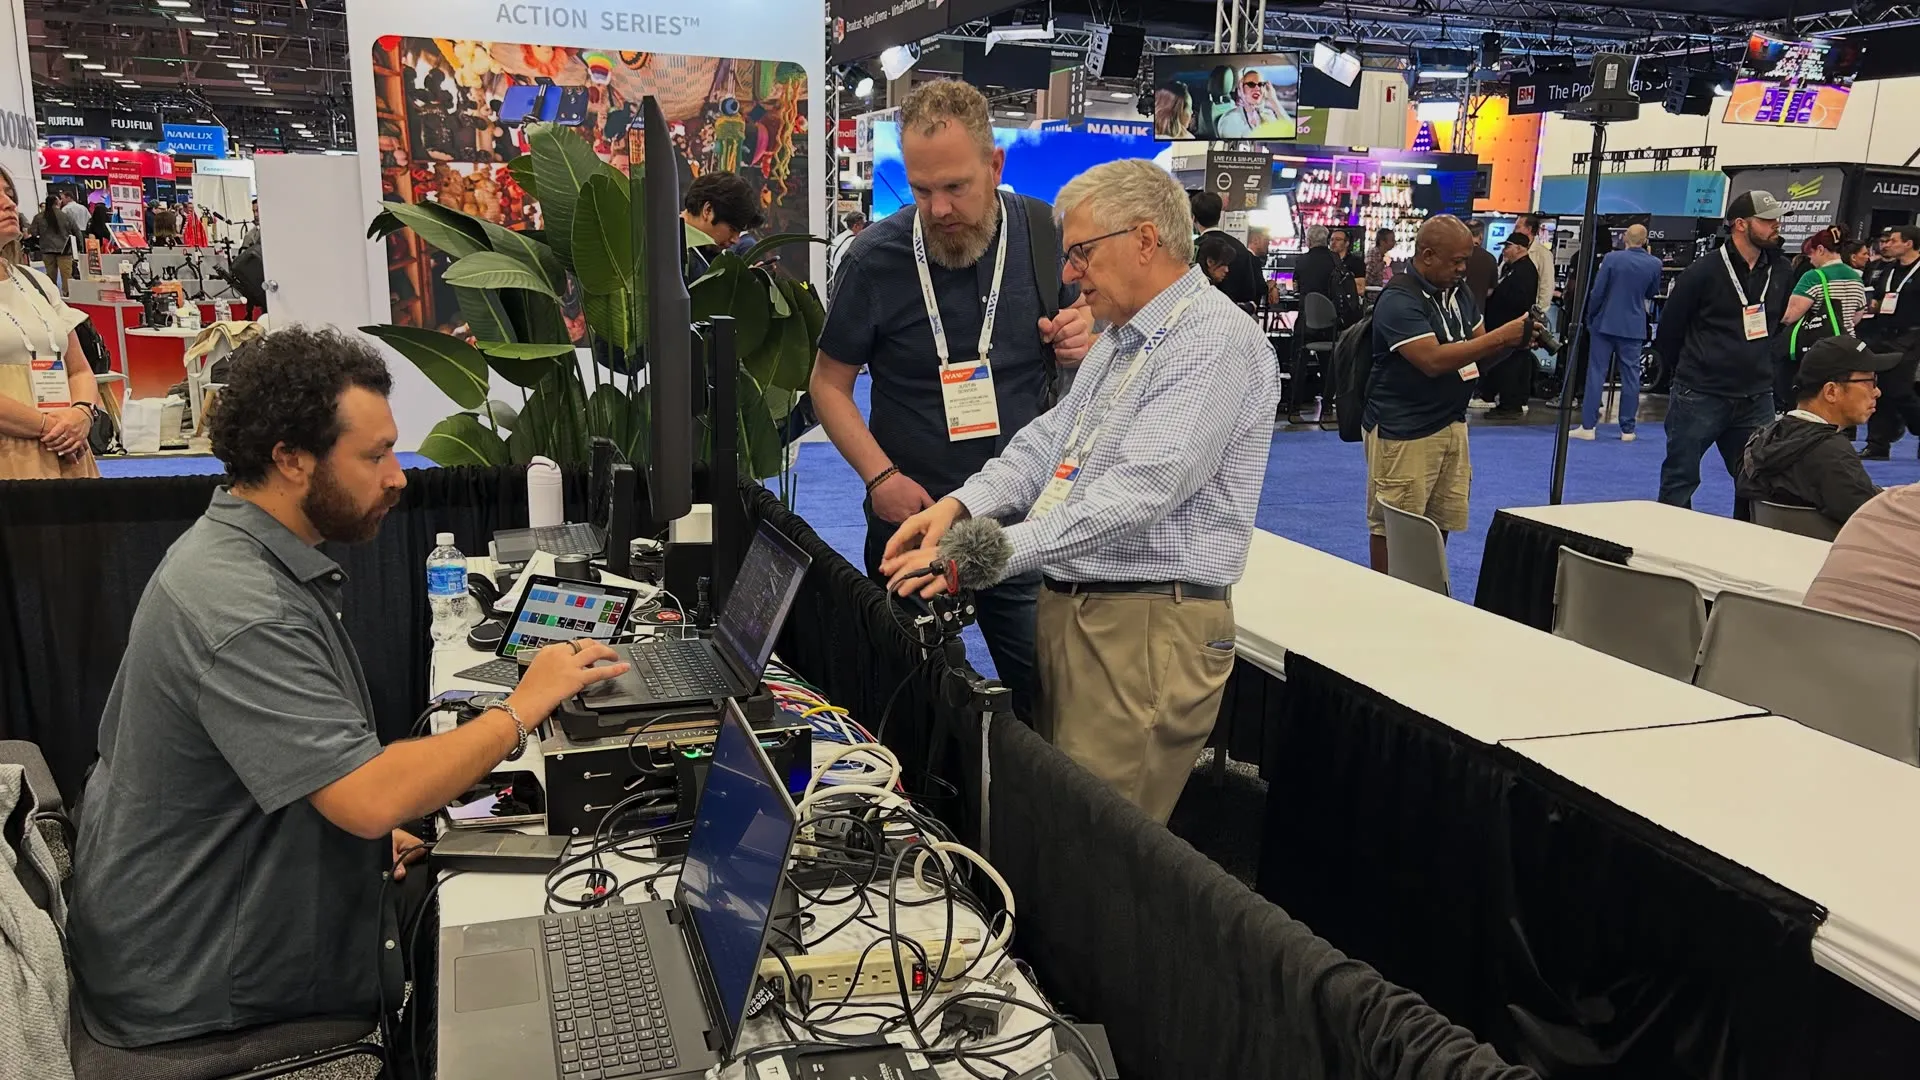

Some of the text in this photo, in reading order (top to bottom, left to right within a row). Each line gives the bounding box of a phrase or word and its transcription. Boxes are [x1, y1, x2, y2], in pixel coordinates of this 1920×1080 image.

[496, 3, 588, 29] ACTION
[1549, 84, 1569, 99] The
[48, 116, 84, 127] FUJIFILM
[111, 118, 153, 131] FUJIFILM
[167, 130, 213, 140] NANLUX
[1087, 123, 1149, 137] NANUK
[168, 142, 214, 151] NANLITE
[59, 155, 71, 168] Z
[85, 180, 107, 189] NDI
[1872, 182, 1920, 196] ALLIED
[746, 990, 775, 1017] Freem
